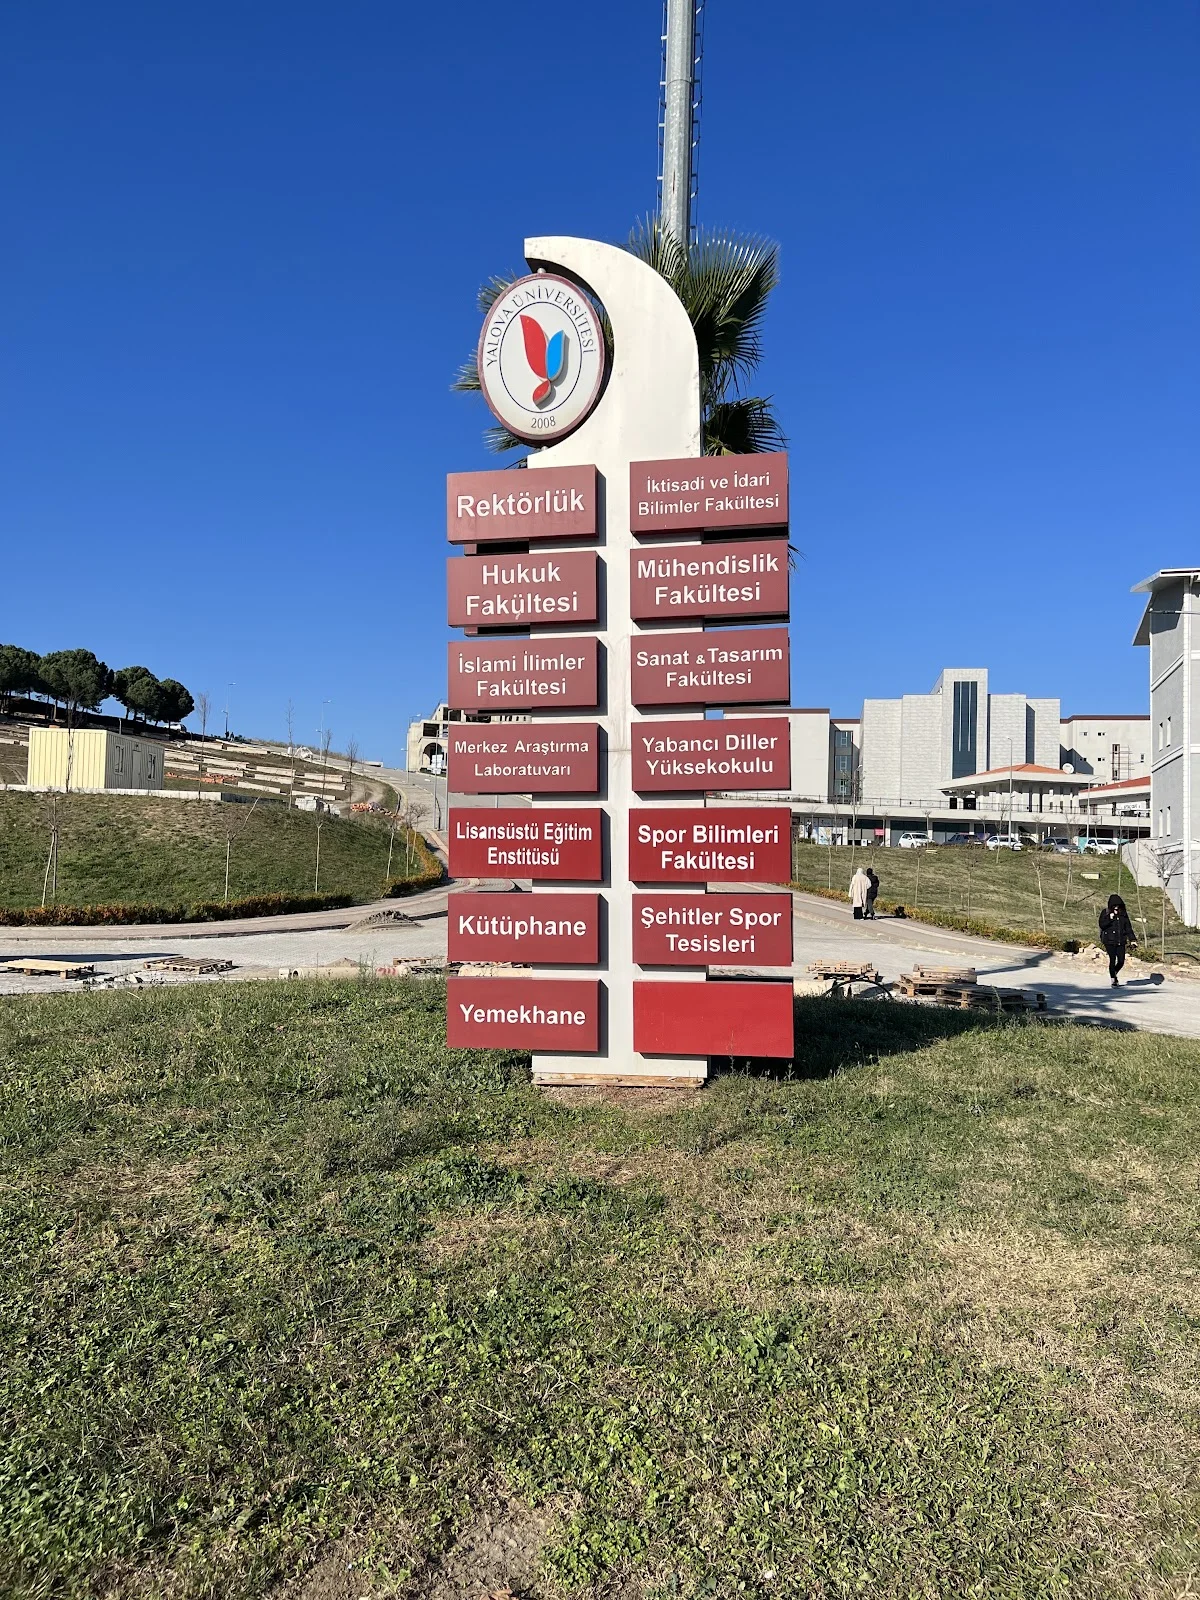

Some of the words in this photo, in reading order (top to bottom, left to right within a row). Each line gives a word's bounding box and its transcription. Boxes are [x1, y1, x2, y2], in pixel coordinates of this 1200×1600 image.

[487, 309, 513, 367] YALOVA
[513, 285, 596, 354] ÜNİVERSİTESİ
[531, 416, 556, 429] 2008
[648, 477, 704, 493] İktisadi
[710, 478, 728, 488] ve
[734, 471, 769, 487] İdari
[458, 489, 584, 517] Rektörlük
[639, 500, 700, 515] Bilimler
[706, 494, 778, 511] Fakültesi
[483, 562, 561, 584] Hukuk
[638, 554, 778, 578] Mühendislik
[467, 591, 577, 616] Fakültesi
[656, 582, 759, 605] Fakültesi
[460, 654, 515, 673] İslami
[524, 651, 585, 671] İlimler
[637, 650, 689, 666] Sanat
[696, 655, 705, 664] &
[707, 648, 782, 663] Tasarım
[478, 678, 565, 696] Fakültesi
[667, 669, 751, 687] Fakültesi
[455, 741, 507, 753] Merkez
[515, 741, 588, 755] Araştırma
[642, 737, 718, 752] Yabancı
[726, 734, 778, 750] Diller
[475, 764, 570, 776] Laboratuvarı
[646, 757, 772, 775] Yüksekokulu
[457, 822, 538, 839] Lisansüstü
[544, 823, 592, 844] Eğitim
[638, 825, 686, 847] Spor
[693, 825, 778, 843] Bilimleri
[488, 847, 559, 865] Enstitüsü
[662, 851, 754, 869] Fakültesi
[460, 916, 586, 939] Kütüphane
[641, 907, 723, 928] Şehitler
[730, 908, 781, 929] Spor
[666, 934, 754, 952] Tesisleri
[460, 1004, 585, 1025] Yemekhane
